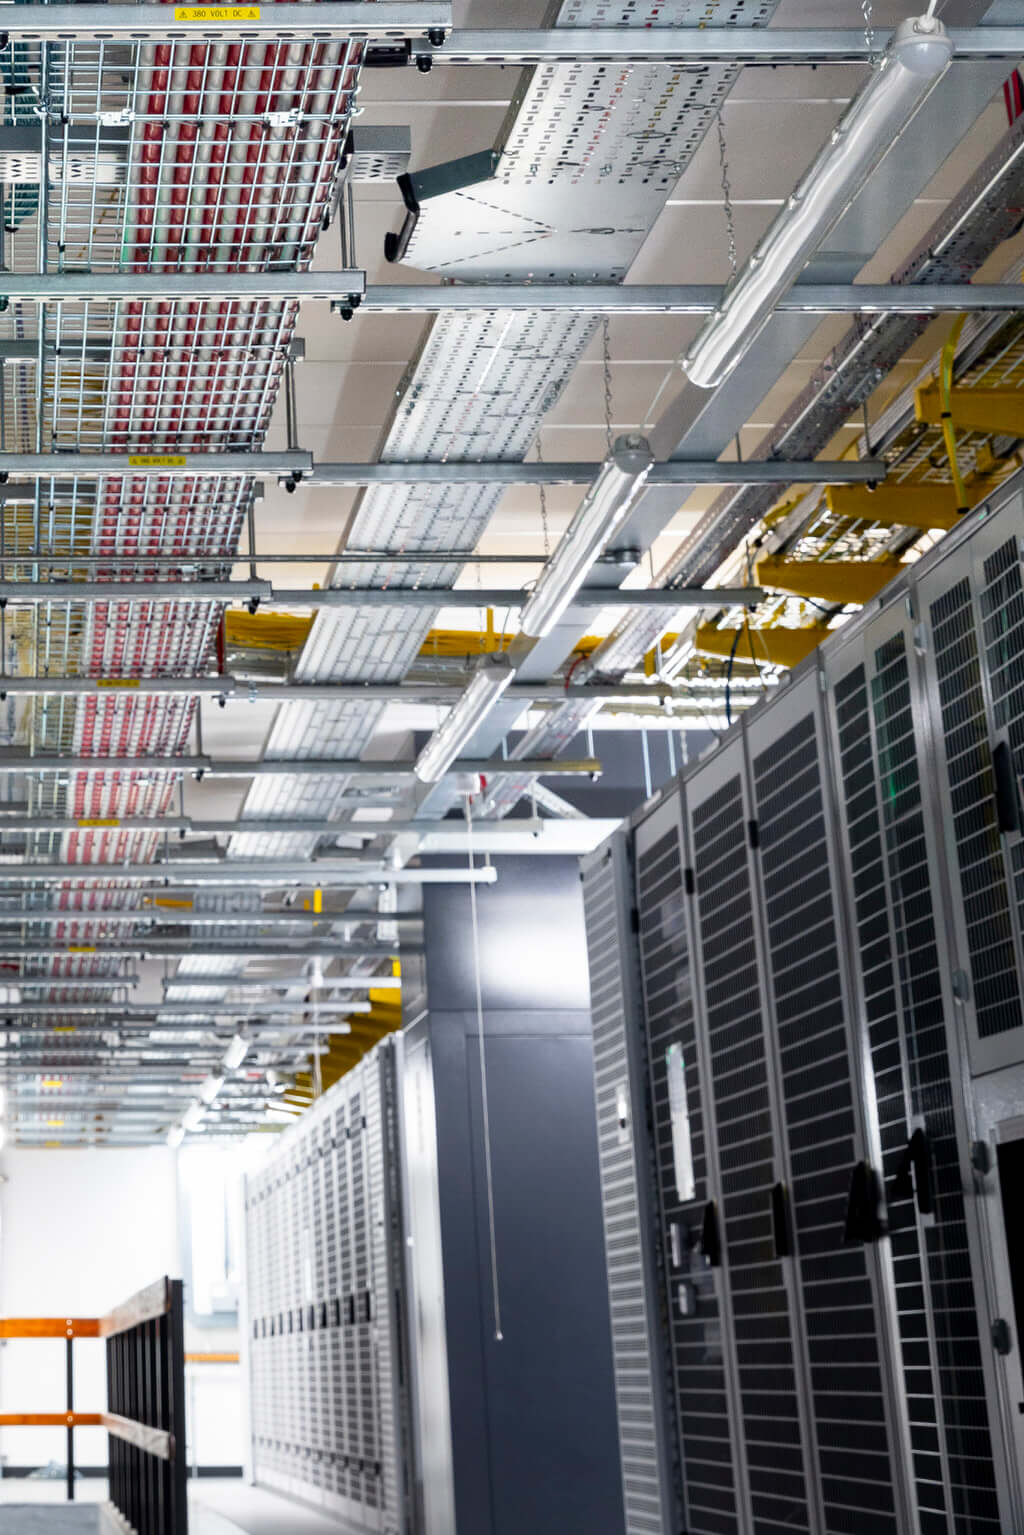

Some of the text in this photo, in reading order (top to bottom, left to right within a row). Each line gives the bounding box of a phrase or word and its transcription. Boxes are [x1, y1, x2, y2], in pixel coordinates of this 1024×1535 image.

[192, 9, 242, 18] 380 VOLT DC
